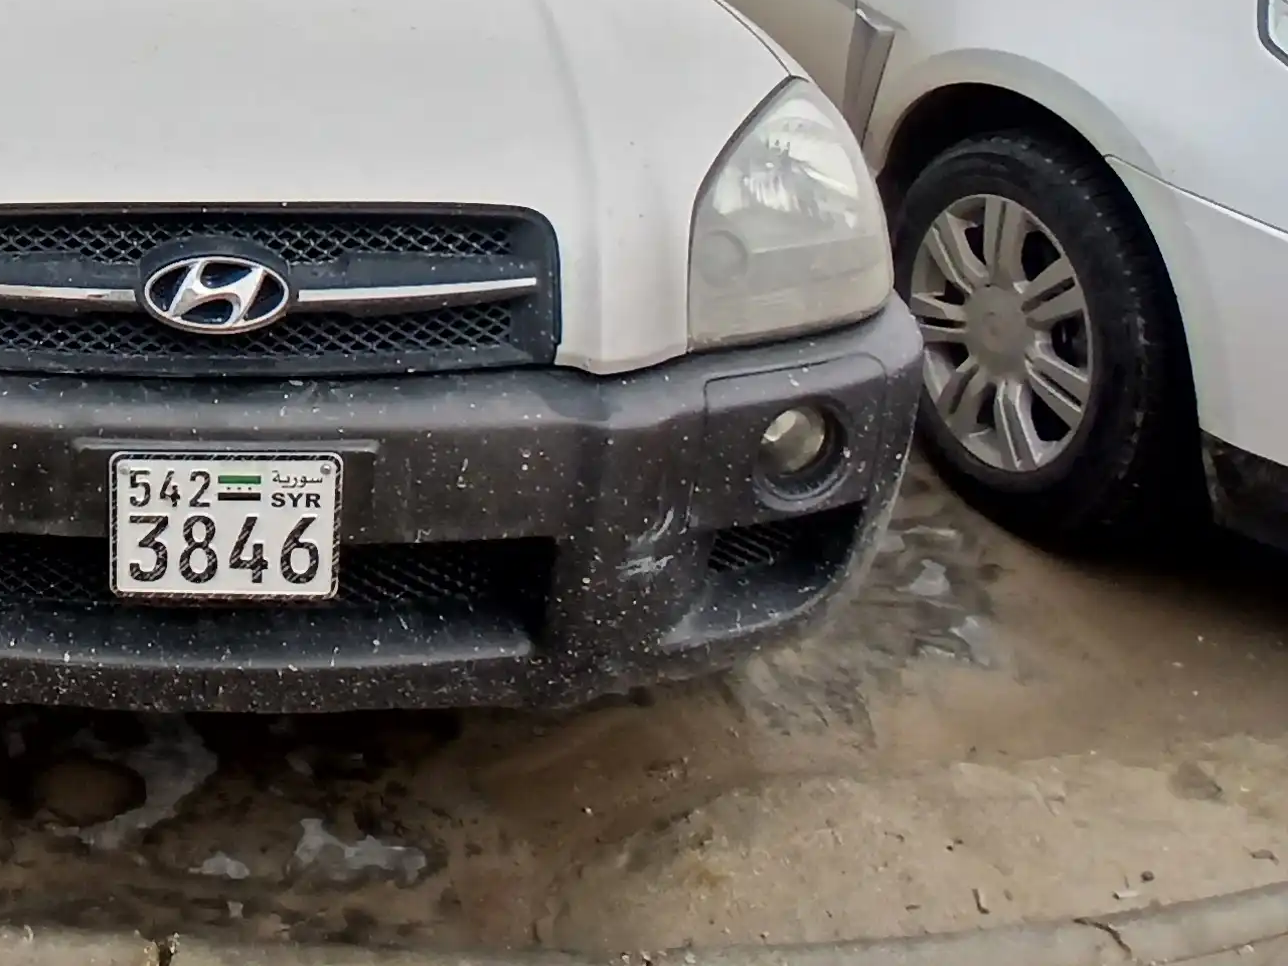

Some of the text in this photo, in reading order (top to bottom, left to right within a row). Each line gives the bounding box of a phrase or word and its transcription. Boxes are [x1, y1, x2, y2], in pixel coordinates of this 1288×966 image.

[129, 469, 211, 508] 542
[271, 470, 323, 489] سورية
[270, 492, 321, 509] SYR
[129, 515, 320, 584] 3846
